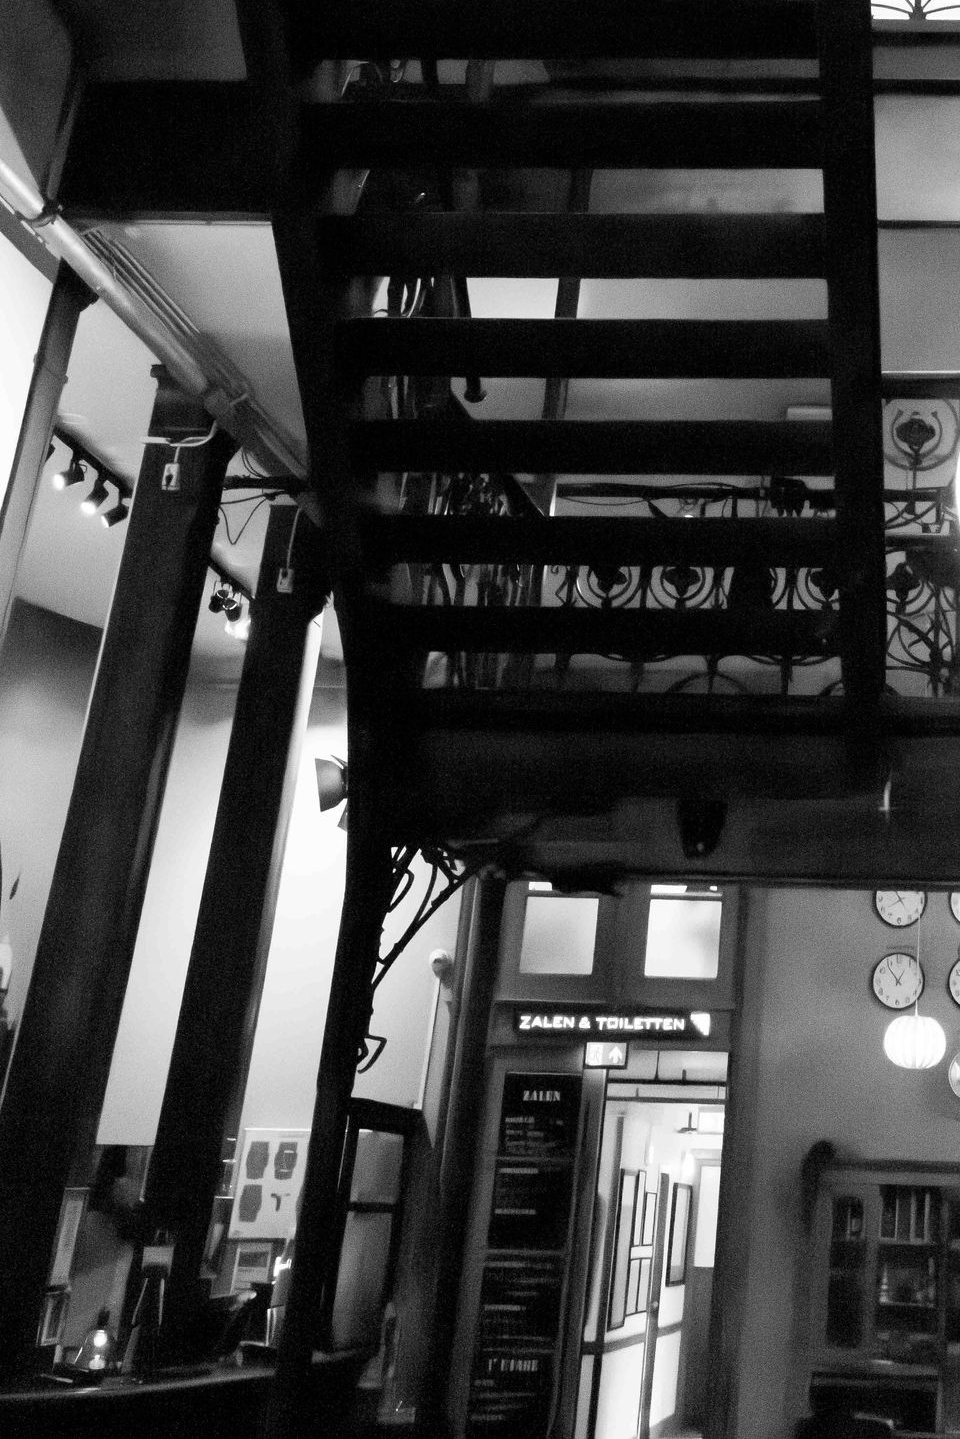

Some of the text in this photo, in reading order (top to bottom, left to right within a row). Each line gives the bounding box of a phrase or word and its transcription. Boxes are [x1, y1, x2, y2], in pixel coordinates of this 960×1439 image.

[519, 1015, 685, 1031] ZALEN & TOILETTEN
[523, 1090, 561, 1102] ZALEN
